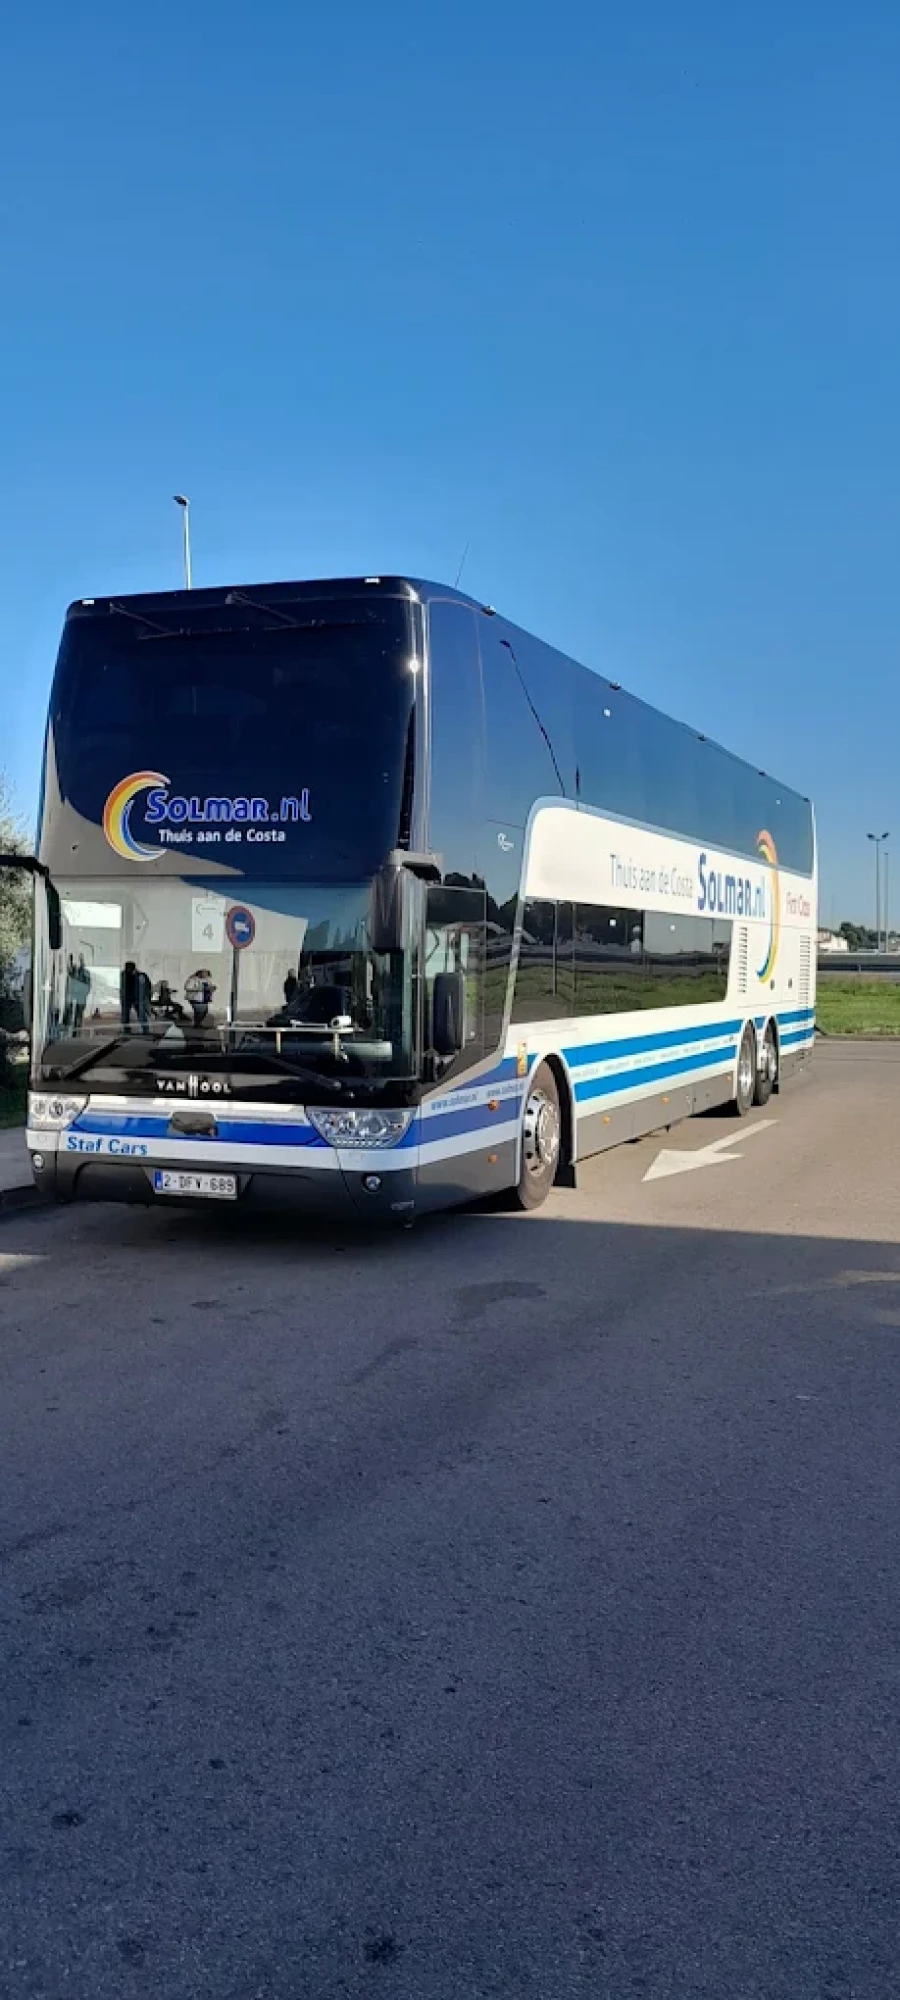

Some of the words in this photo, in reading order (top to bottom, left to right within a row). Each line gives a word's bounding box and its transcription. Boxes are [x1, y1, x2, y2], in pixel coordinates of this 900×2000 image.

[159, 829, 193, 842] Thuis
[197, 831, 220, 842] aan
[225, 829, 242, 842] de
[247, 829, 286, 842] Costa
[610, 853, 637, 889] Thuis
[639, 867, 656, 892] aan
[659, 865, 669, 895] de
[671, 867, 693, 899] Costa
[66, 1136, 102, 1152] Staf
[108, 1138, 148, 1156] Cars
